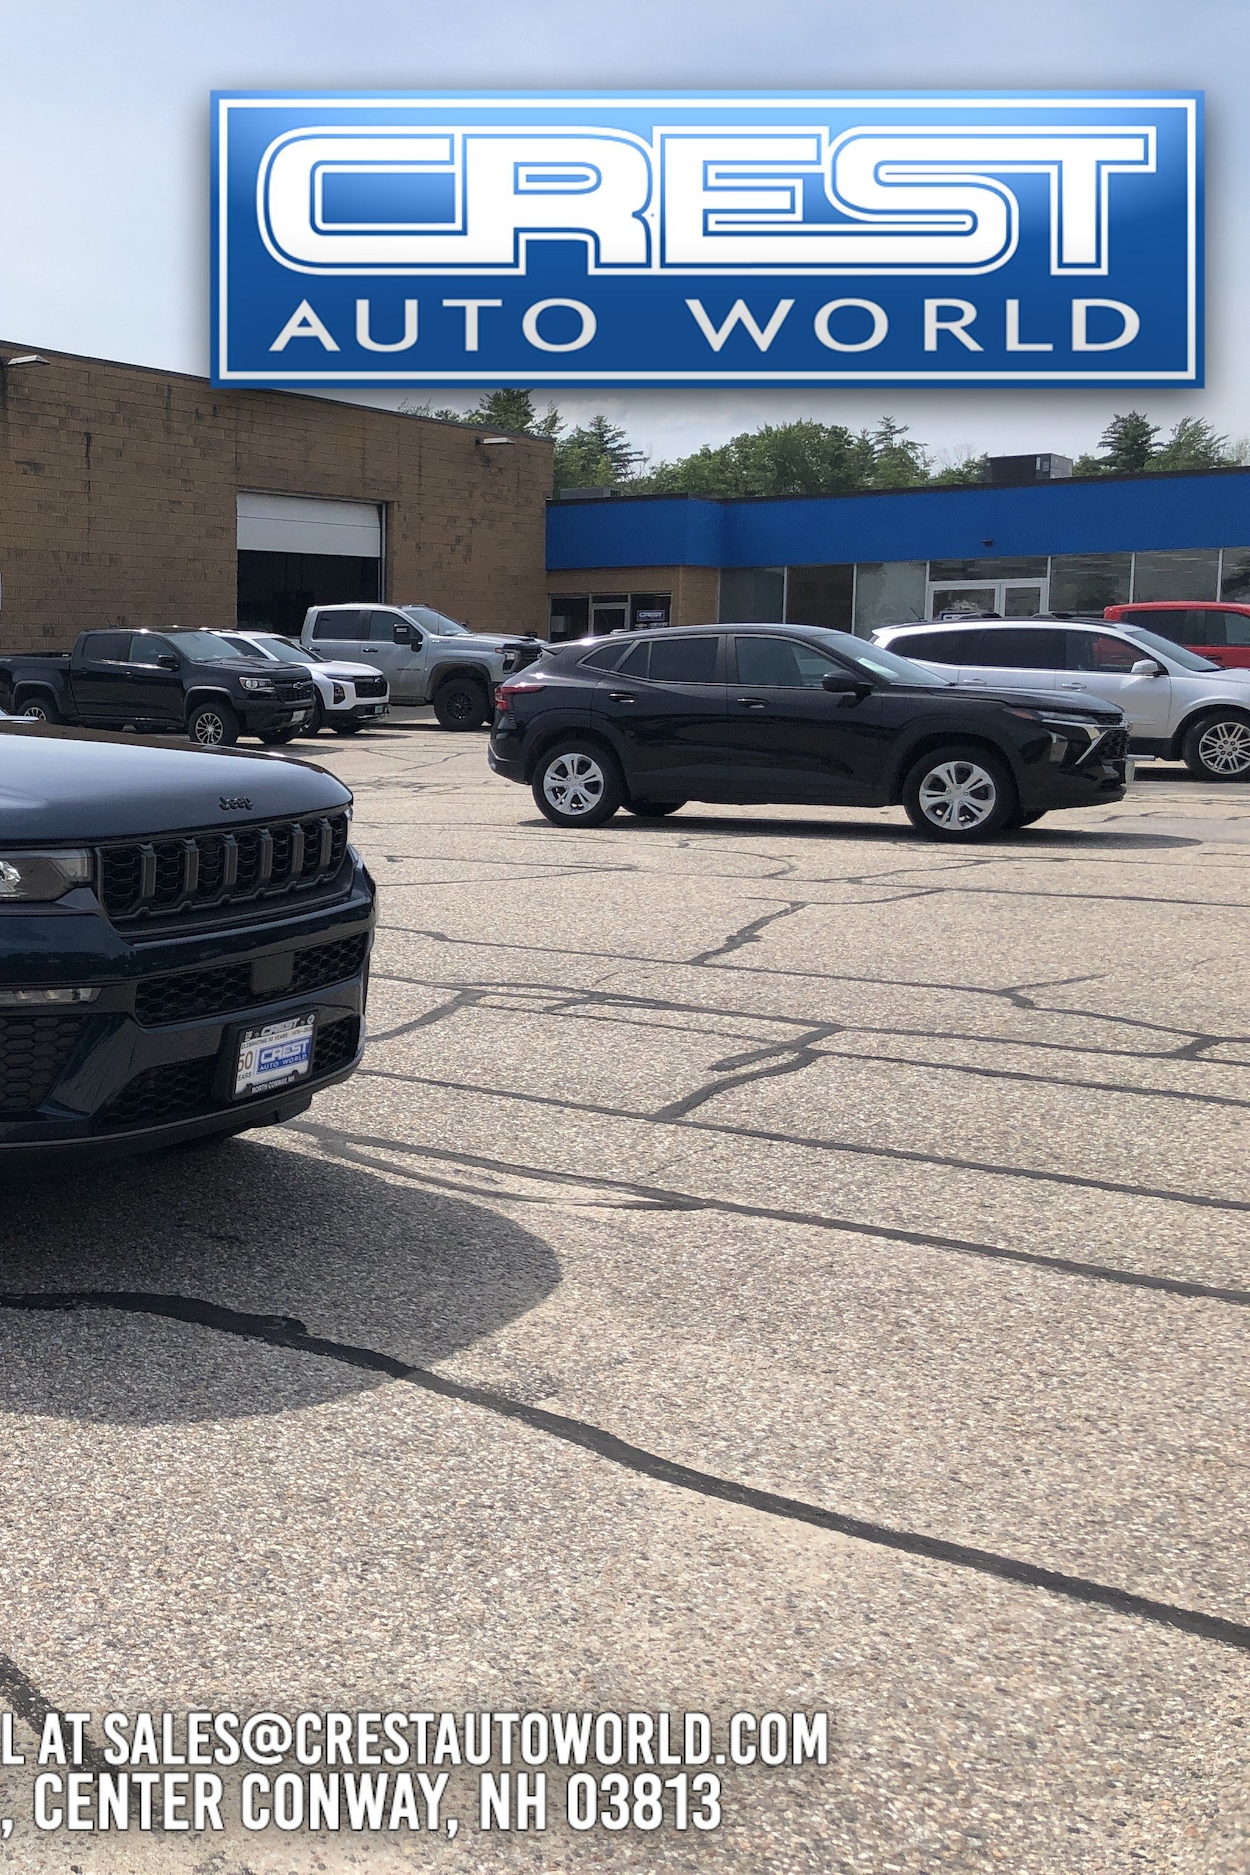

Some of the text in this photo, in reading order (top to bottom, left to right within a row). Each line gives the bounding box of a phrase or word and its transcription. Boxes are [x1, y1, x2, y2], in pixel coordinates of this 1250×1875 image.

[218, 796, 253, 811] Jeep
[261, 1017, 300, 1036] CREST
[261, 1039, 310, 1064] CREST
[237, 1050, 254, 1073] 50
[259, 1053, 308, 1072] AUTO WORLD
[237, 1071, 252, 1082] EARS
